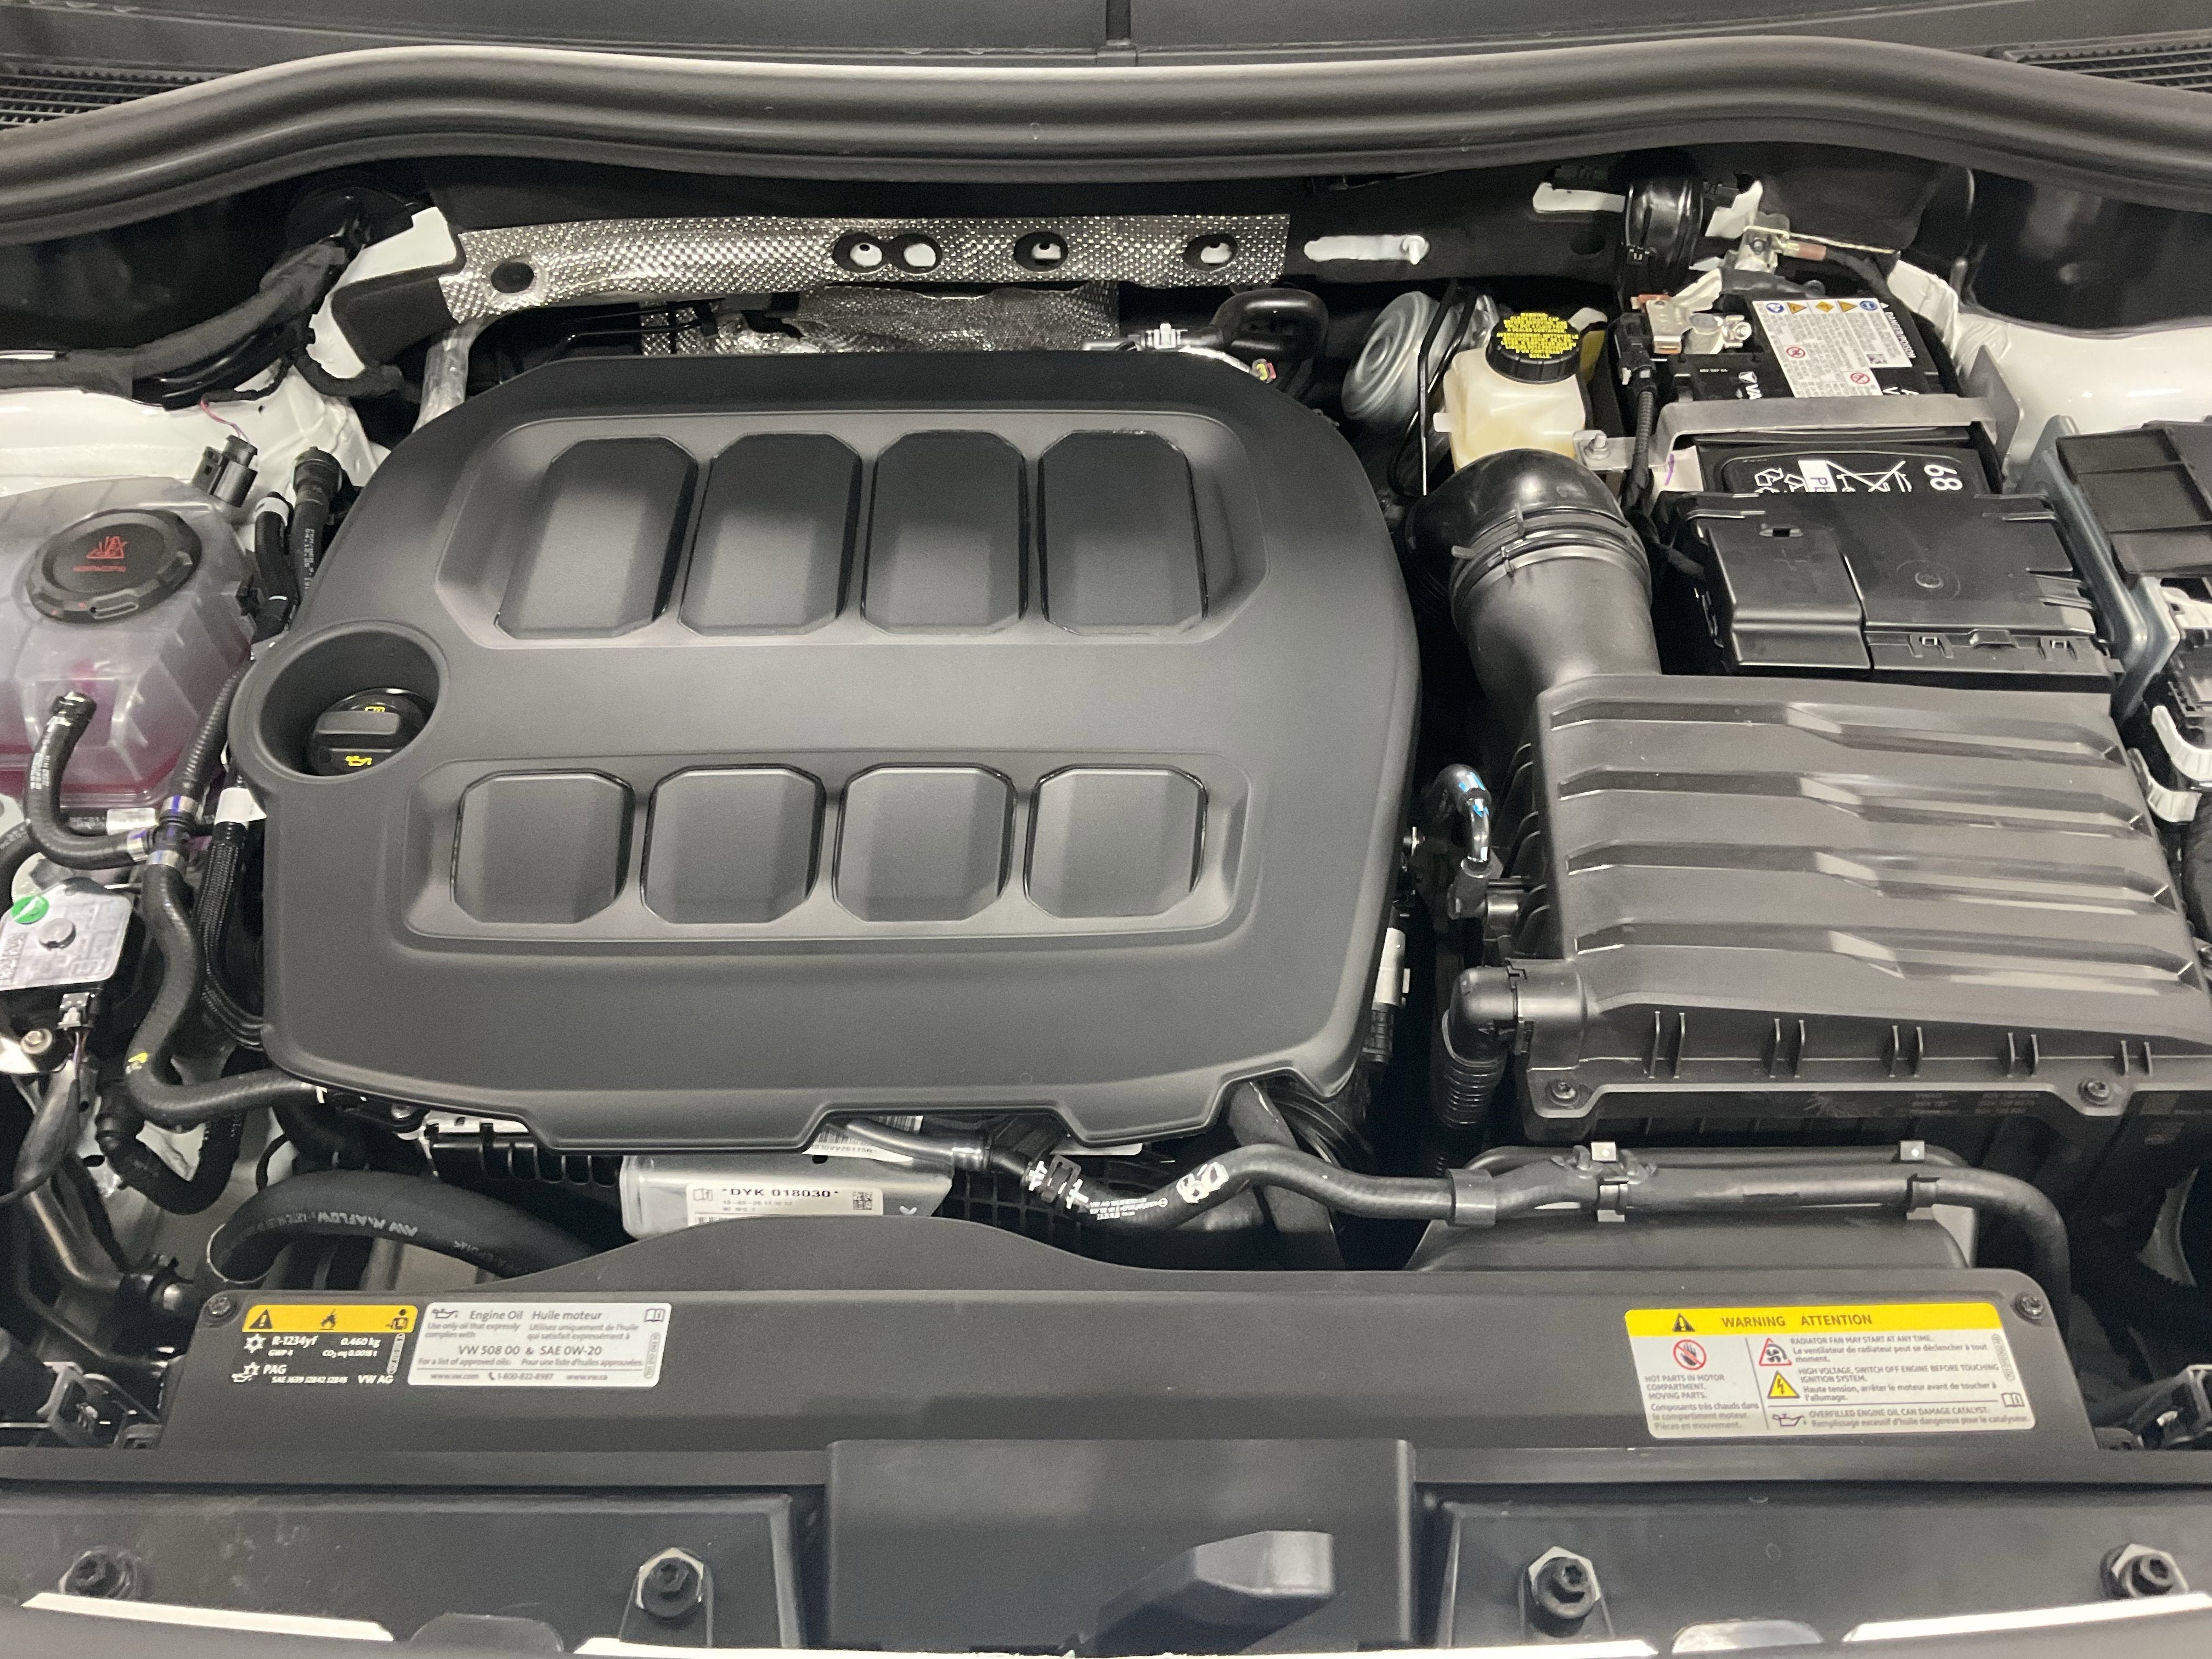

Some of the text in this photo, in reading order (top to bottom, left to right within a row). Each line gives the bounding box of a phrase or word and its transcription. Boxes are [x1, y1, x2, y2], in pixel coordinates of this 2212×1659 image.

[1924, 464, 1963, 490] 68
[470, 1310, 602, 1322] Engine Oil Huile moteur
[1722, 1313, 1872, 1328] WARNING ATTENTION
[443, 1323, 458, 1331] only
[486, 1323, 521, 1331] expressly
[272, 1335, 381, 1348] R-1234yf 0.460 kg
[459, 1345, 479, 1355] VW
[481, 1345, 503, 1355] 508
[505, 1345, 520, 1355] 00
[540, 1346, 562, 1355] SAE
[564, 1346, 602, 1355] 0W-20
[460, 1358, 494, 1368] approved
[263, 1364, 287, 1374] PAG
[358, 1375, 394, 1384] VW AG
[1651, 1403, 1696, 1412] Composants
[1662, 1413, 1716, 1423] compartiment
[1812, 1420, 1859, 1428] Remplissage
[1893, 1417, 1918, 1425] d'huile
[1920, 1417, 1960, 1426] dangereux
[1989, 1415, 2028, 1424] catalyseur.
[1655, 1421, 1679, 1430] Pièces
